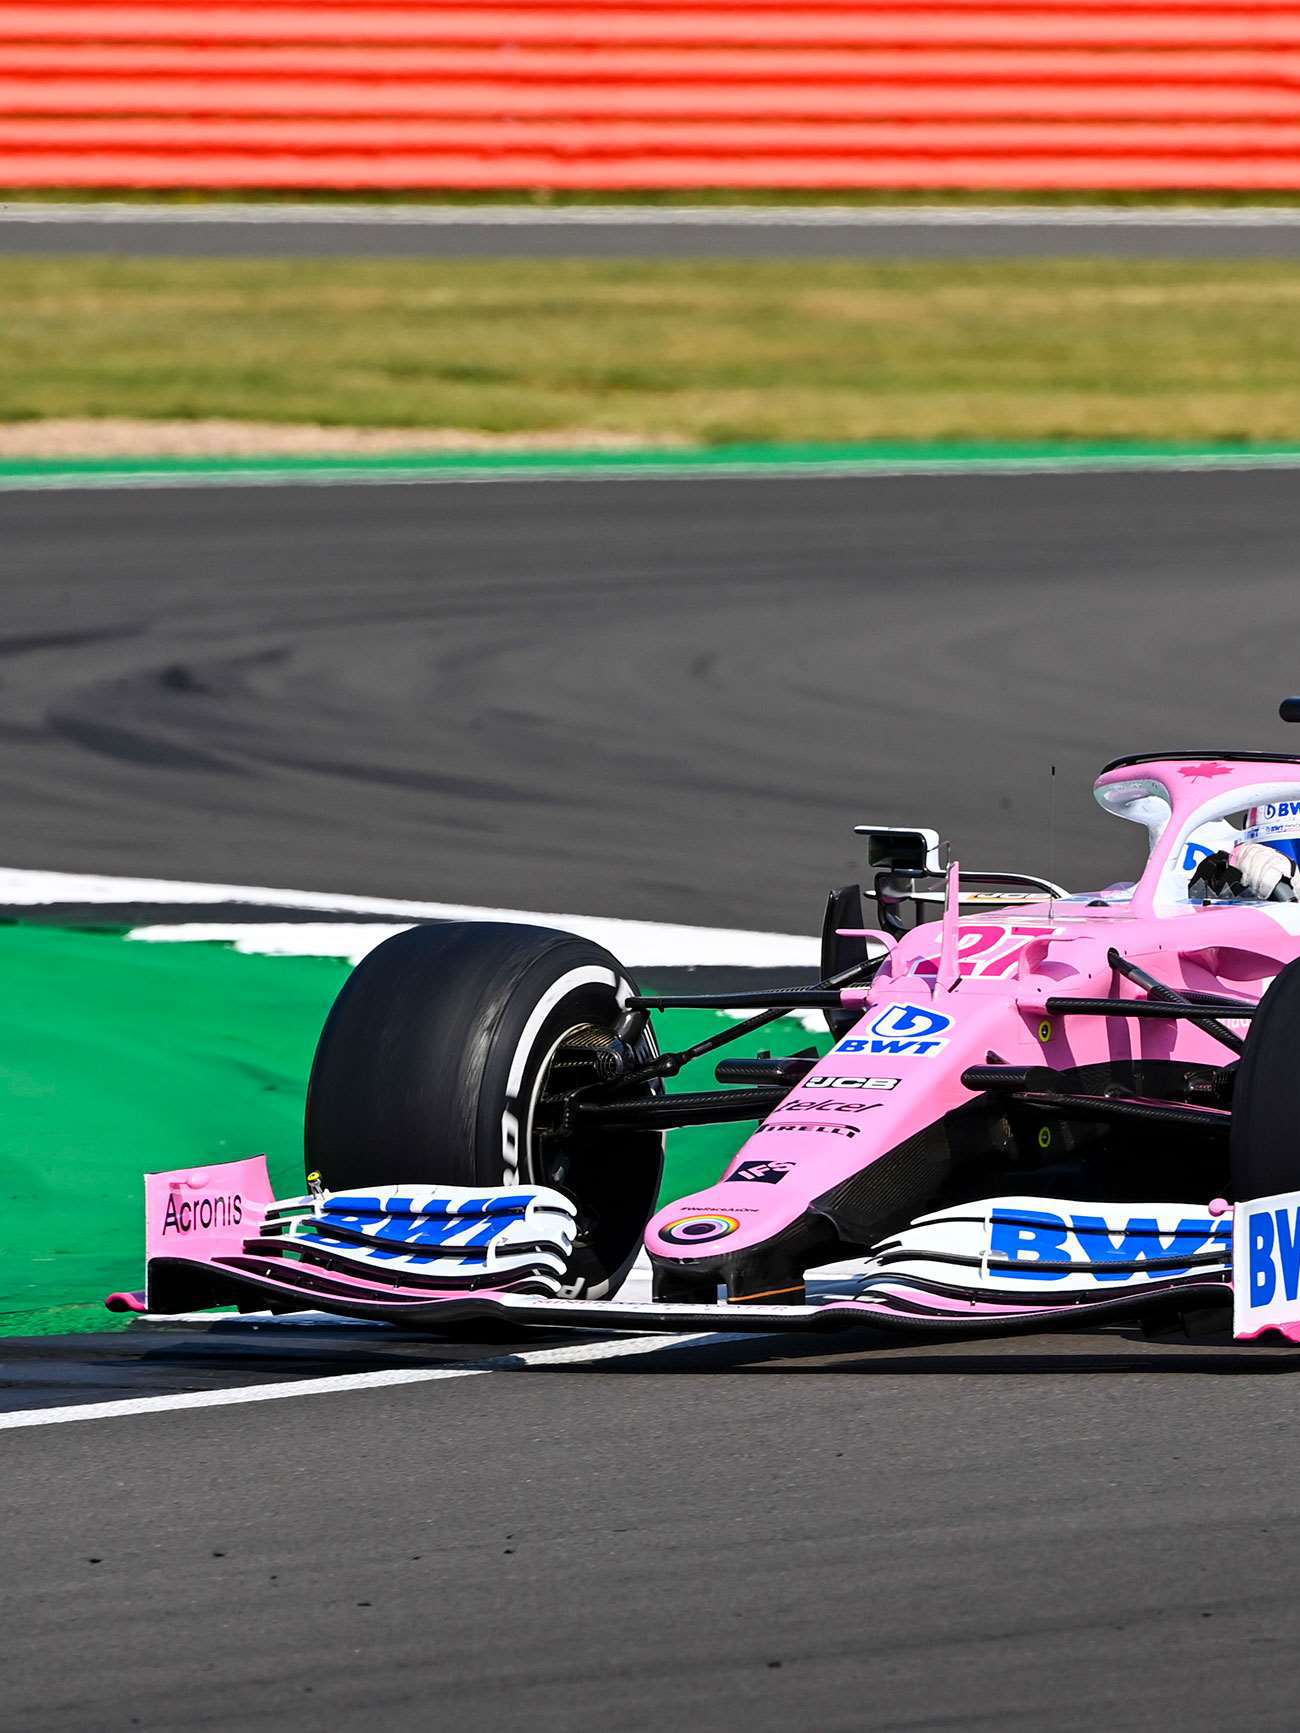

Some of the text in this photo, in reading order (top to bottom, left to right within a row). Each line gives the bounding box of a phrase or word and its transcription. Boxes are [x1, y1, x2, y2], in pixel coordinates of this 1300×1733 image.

[836, 1039, 941, 1055] BWT
[804, 1076, 899, 1090] JCB
[774, 1099, 884, 1113] telcel
[161, 1193, 243, 1236] Acronis
[294, 1195, 537, 1266] BWT
